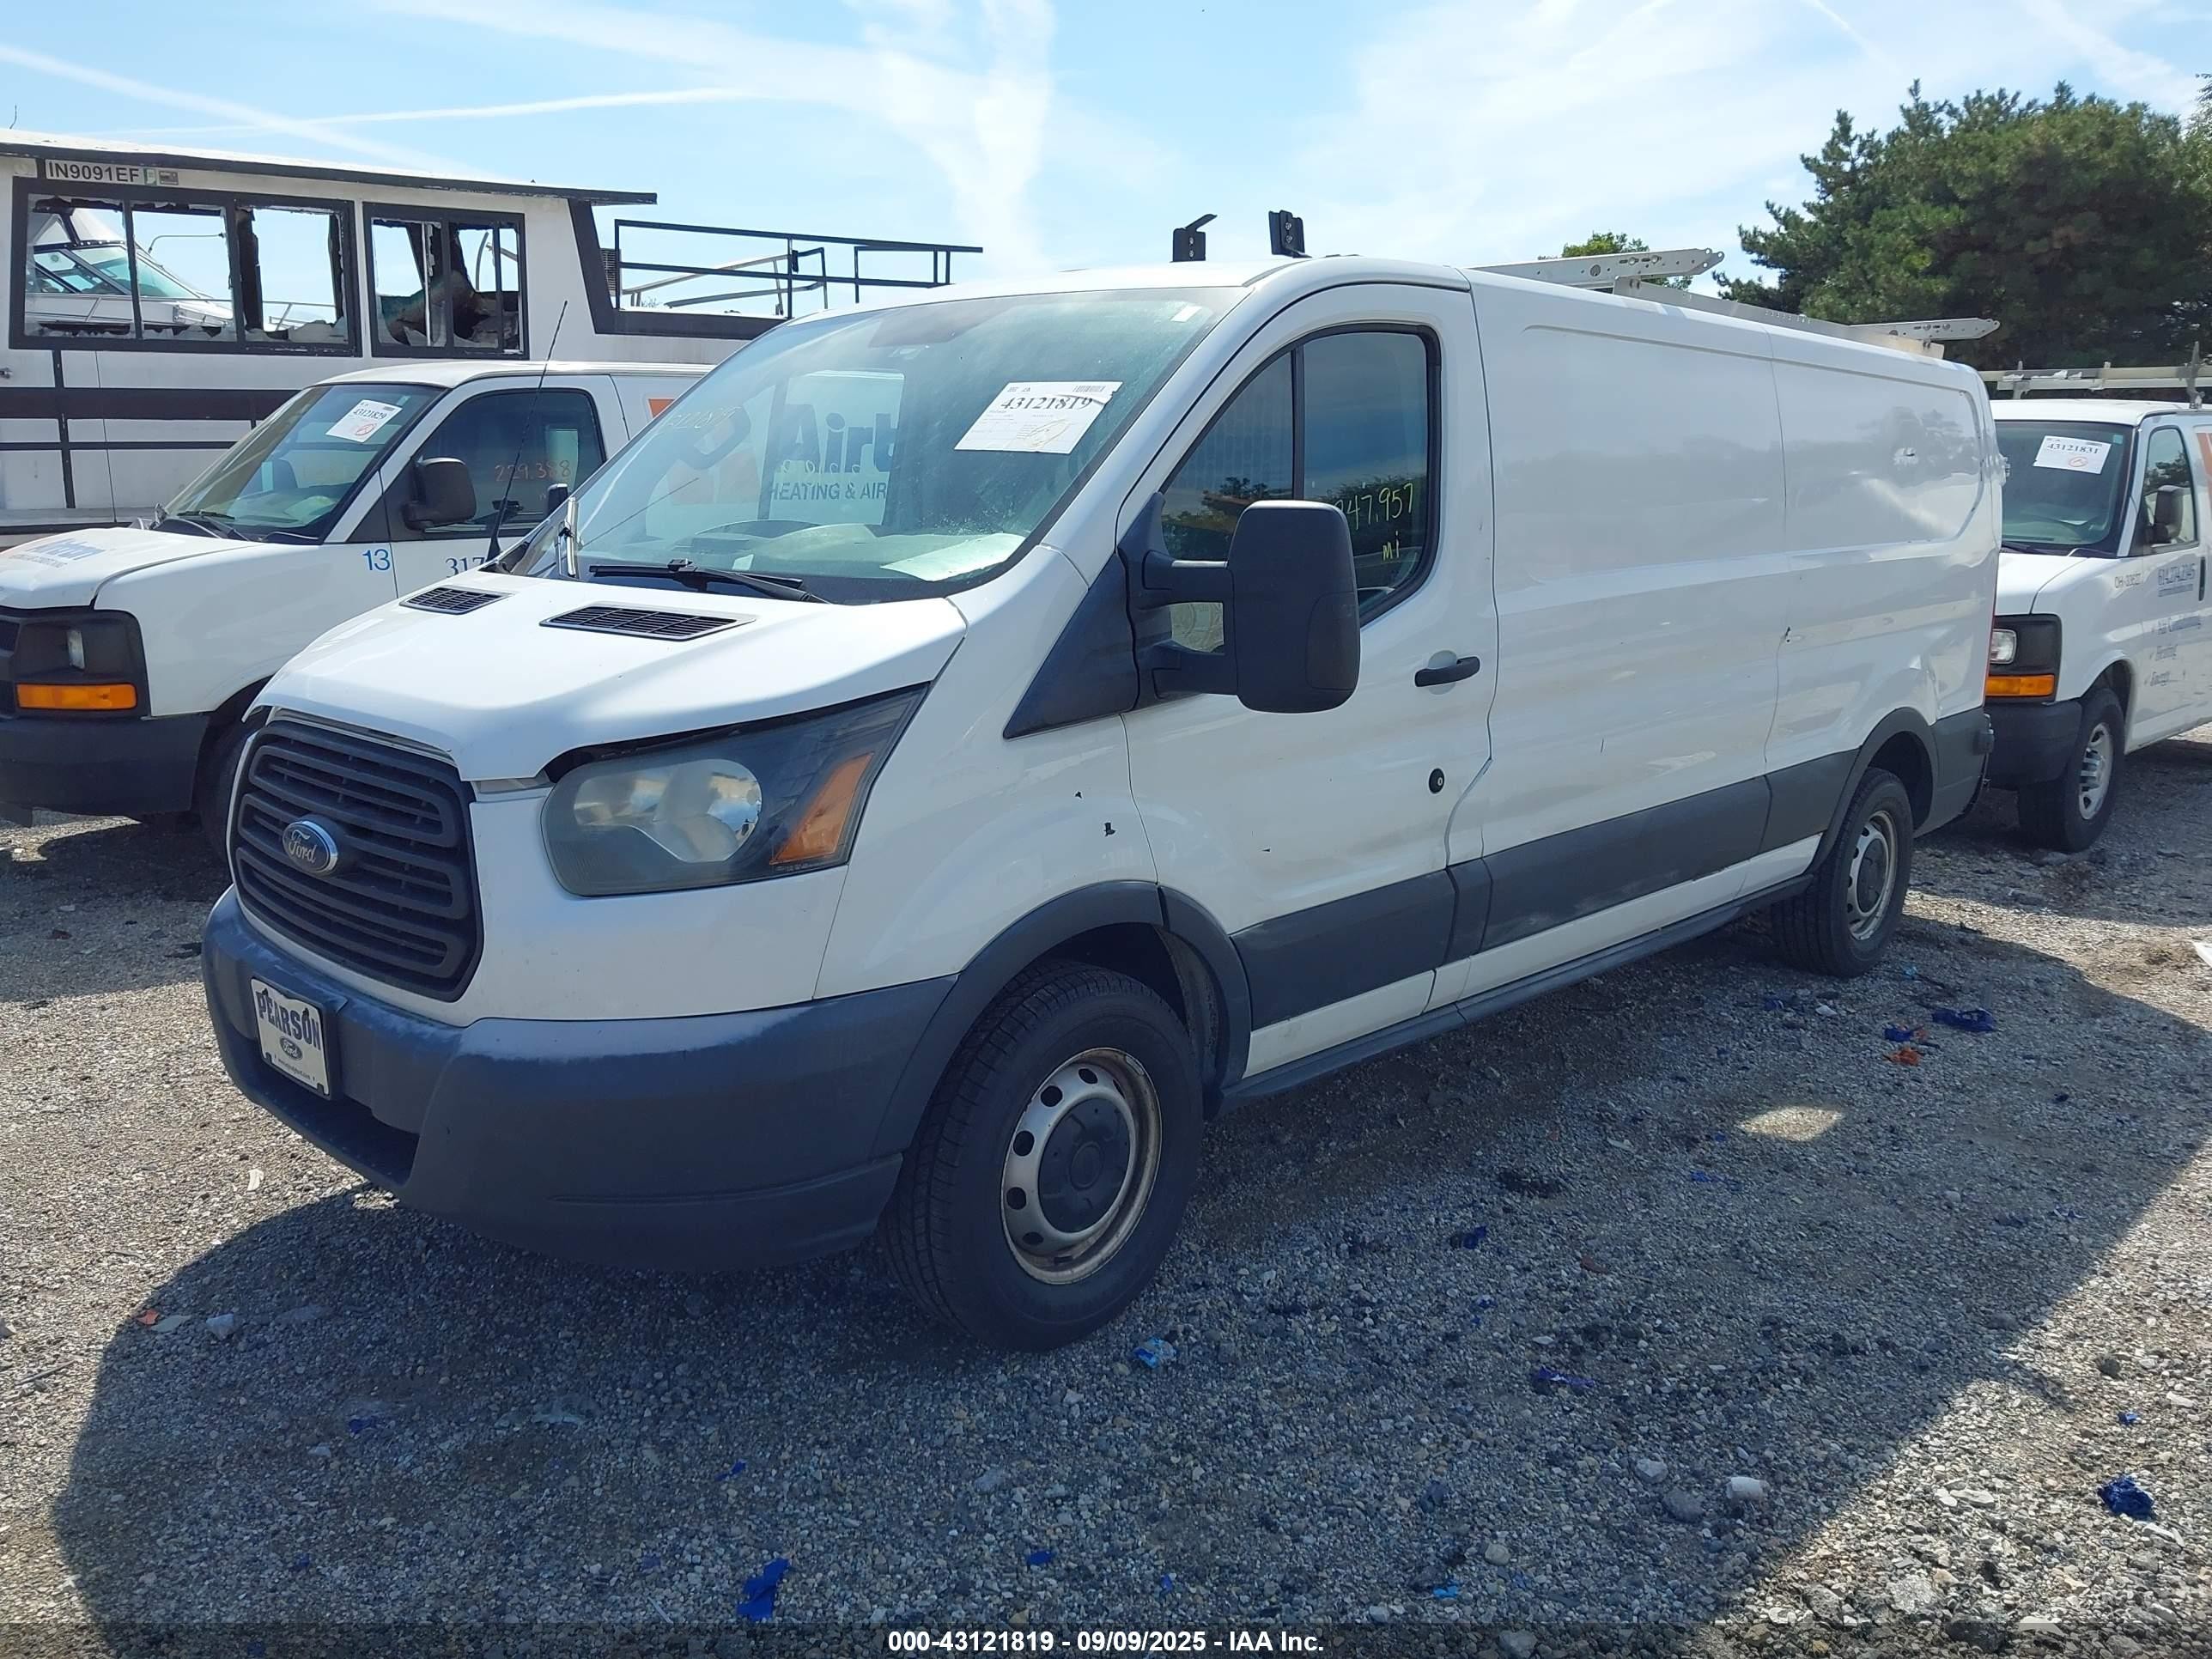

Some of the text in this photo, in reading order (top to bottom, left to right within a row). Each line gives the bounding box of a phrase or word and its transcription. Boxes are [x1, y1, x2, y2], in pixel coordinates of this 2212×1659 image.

[48, 161, 139, 182] IN9091EF
[1000, 396, 1093, 410] 43121819
[2046, 443, 2099, 454] 43121831
[844, 481, 856, 500] &
[860, 481, 887, 500] AIR
[362, 549, 391, 571] 13
[288, 829, 318, 864] Ford
[256, 991, 321, 1051] PEARSON
